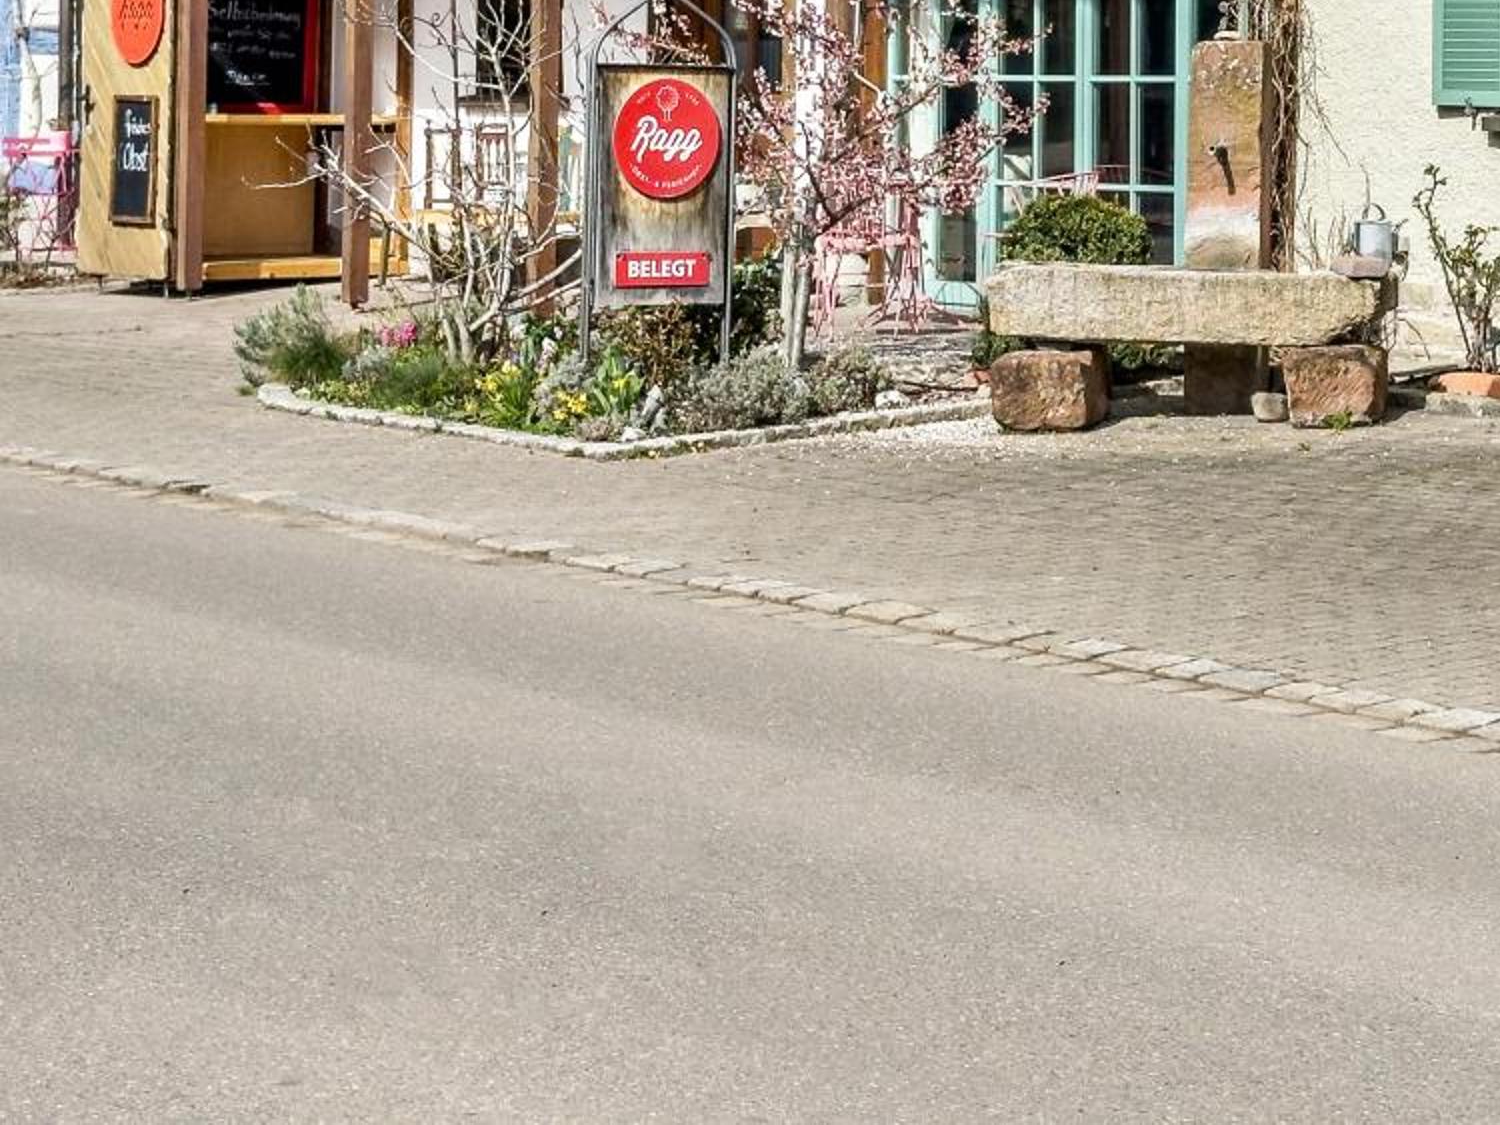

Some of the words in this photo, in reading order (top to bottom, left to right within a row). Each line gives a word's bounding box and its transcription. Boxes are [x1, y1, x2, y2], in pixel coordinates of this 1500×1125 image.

[630, 115, 704, 164] Ragg
[122, 142, 149, 172] Obst
[627, 259, 697, 279] BELEGT
